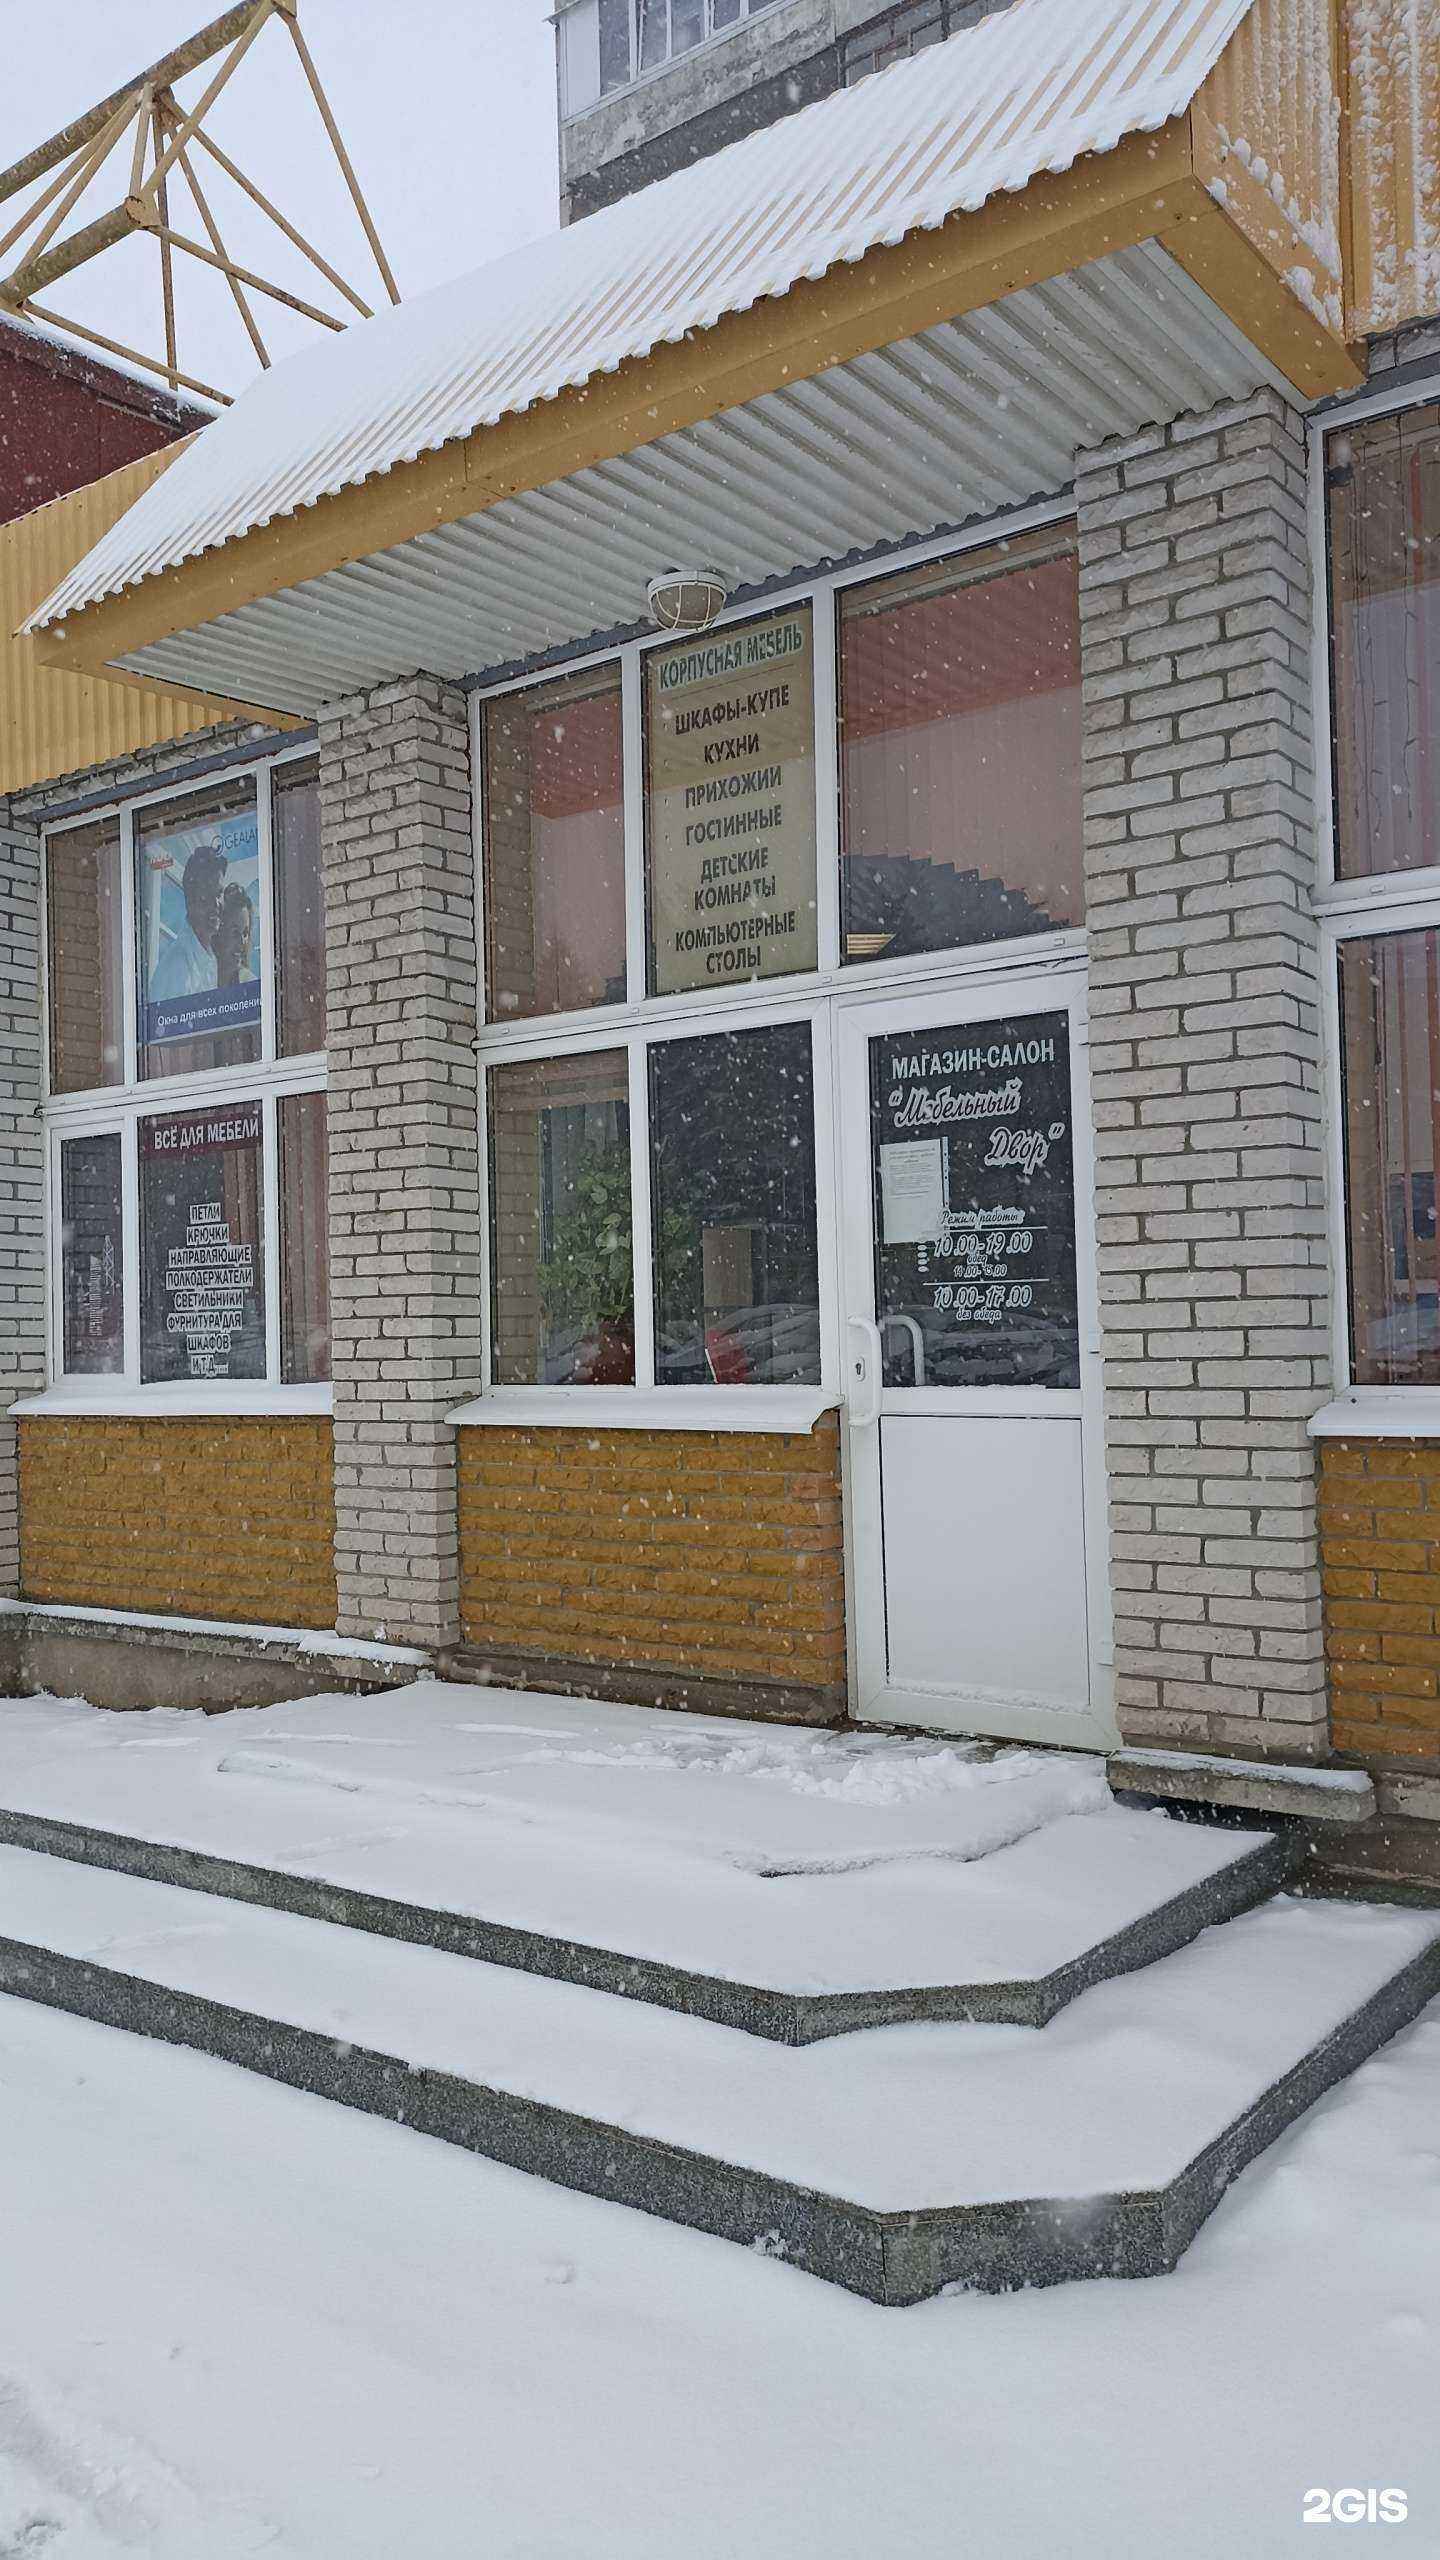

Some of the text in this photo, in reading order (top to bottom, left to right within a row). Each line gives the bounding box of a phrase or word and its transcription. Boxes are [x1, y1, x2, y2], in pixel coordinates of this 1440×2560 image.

[659, 623, 802, 689] КОРПУСНАЯ МЕБЕЛЬ
[675, 684, 789, 735] ШКАФЫ-КУПЕ
[704, 733, 759, 764] КУХНИ
[686, 804, 782, 846] ГОСТИННЫЕ
[701, 847, 768, 884] ДЕТСКИЕ
[694, 875, 776, 911] КОМНАТЫ
[675, 911, 796, 952] КОМПЬЮТЕРНЫЕ
[706, 946, 761, 974] СТОЛЫ
[158, 1015, 178, 1026] Окна
[180, 1011, 196, 1022] для
[198, 1007, 217, 1018] всех
[892, 1039, 1054, 1080] МАГАЗИН-САЛОН
[154, 1118, 259, 1150] ВСЁ ДЛЯ МЕБЕЛИ
[191, 1205, 220, 1221] ПЕТЛИ
[977, 1208, 1020, 1226] работы
[187, 1226, 229, 1243] КРЮЧКИ
[170, 1246, 251, 1266] НАПРАВЛЯЮЩИЕ
[167, 1269, 253, 1288] ПОЛКОДЕРЖАТЕЛИ
[176, 1292, 242, 1308] СВЕТИЛЬНИКИ
[168, 1312, 241, 1331] ФУРНИТУРА ДЛЯ
[975, 1306, 1001, 1323] обеда
[187, 1335, 230, 1351] ШКАФОВ
